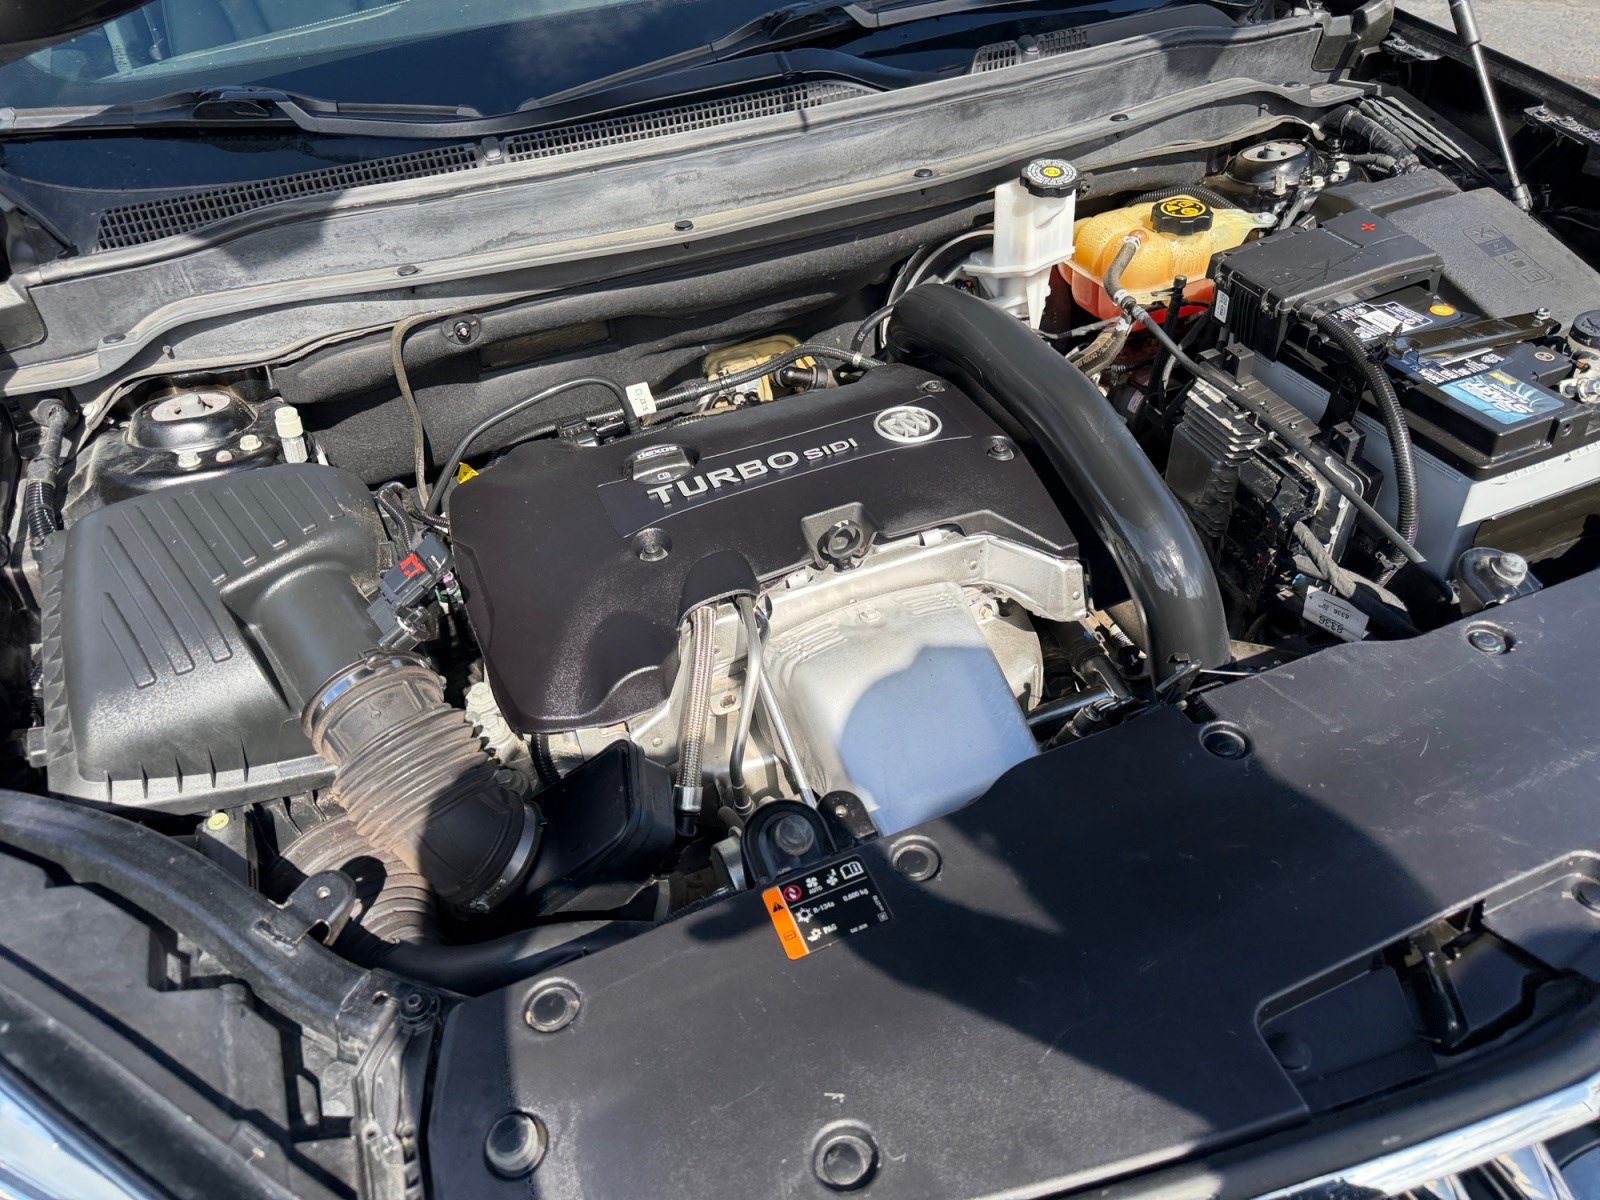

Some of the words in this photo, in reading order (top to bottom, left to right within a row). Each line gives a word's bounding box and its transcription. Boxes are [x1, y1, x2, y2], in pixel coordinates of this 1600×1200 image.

[637, 446, 678, 460] dexos
[647, 451, 799, 504] TURBO
[803, 437, 858, 462] SIDI
[1319, 615, 1344, 634] 8336
[812, 901, 836, 914] R-134a
[859, 888, 870, 896] kg
[822, 923, 838, 935] PAG
